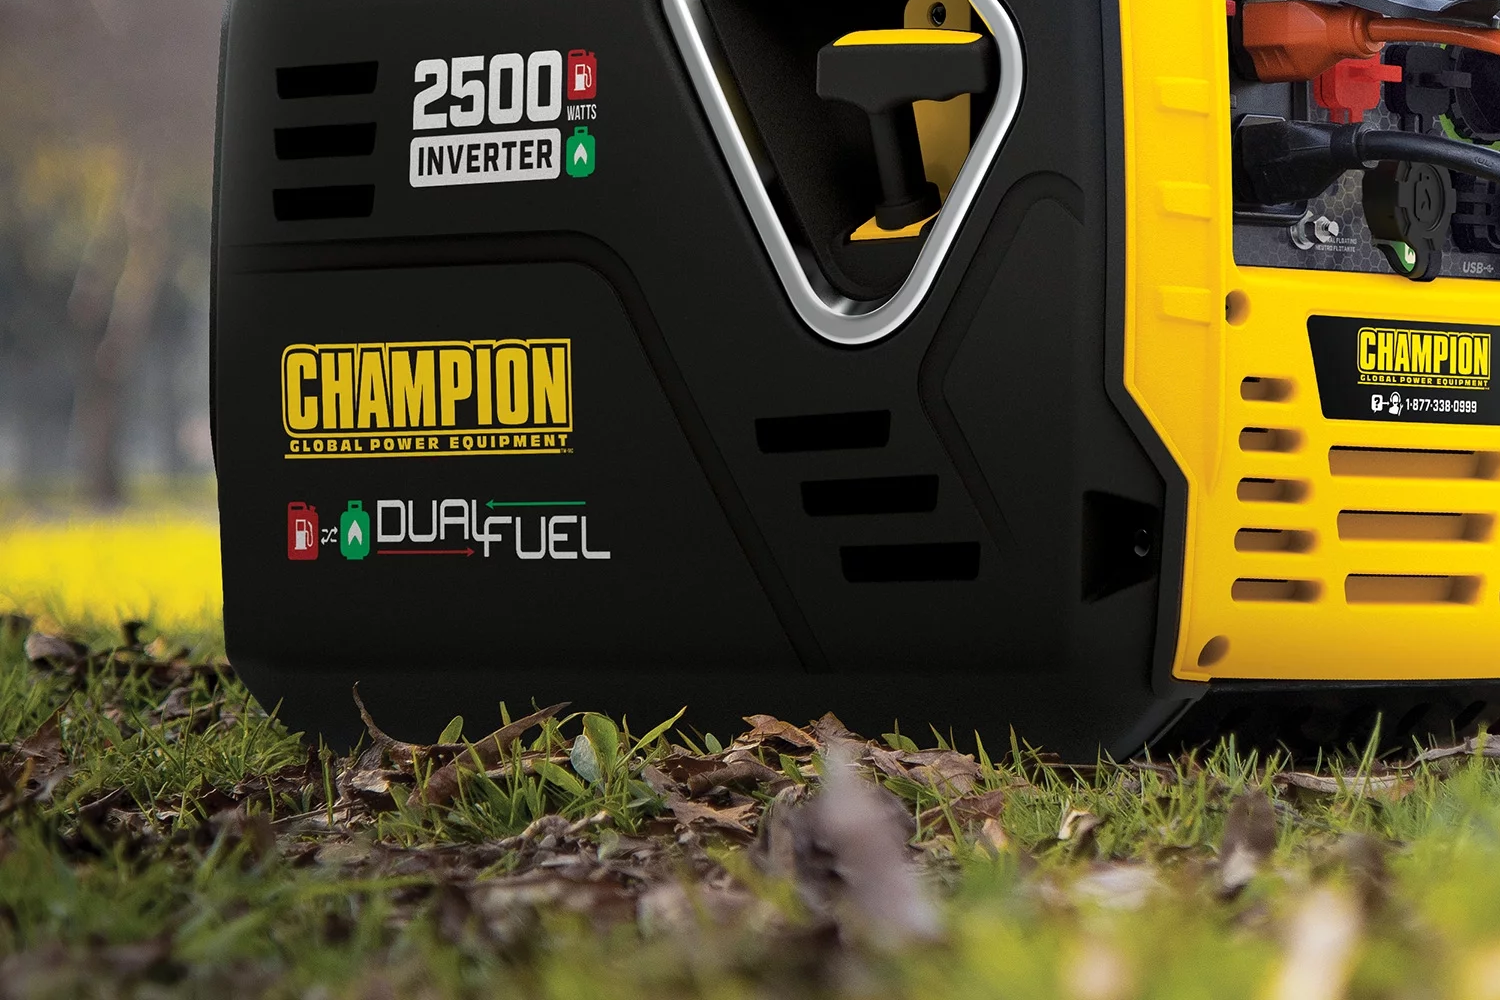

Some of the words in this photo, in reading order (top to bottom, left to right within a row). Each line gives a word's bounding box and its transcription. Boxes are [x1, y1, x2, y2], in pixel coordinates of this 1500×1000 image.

[413, 50, 562, 130] 2500
[566, 104, 597, 121] WATTS
[418, 138, 553, 177] INVERTER
[1463, 261, 1484, 274] USB
[1359, 329, 1489, 376] CHAMPION
[286, 344, 569, 430] CHAMPION
[1360, 374, 1397, 383] GLOBAL
[1400, 377, 1433, 385] POWER
[1436, 378, 1489, 387] EQUIPMENT
[289, 438, 363, 453] GLOBAL
[369, 436, 440, 451] POWER
[448, 433, 568, 449] EQUIPMENT
[377, 498, 502, 542] DUAL
[484, 516, 611, 560] FUEL
